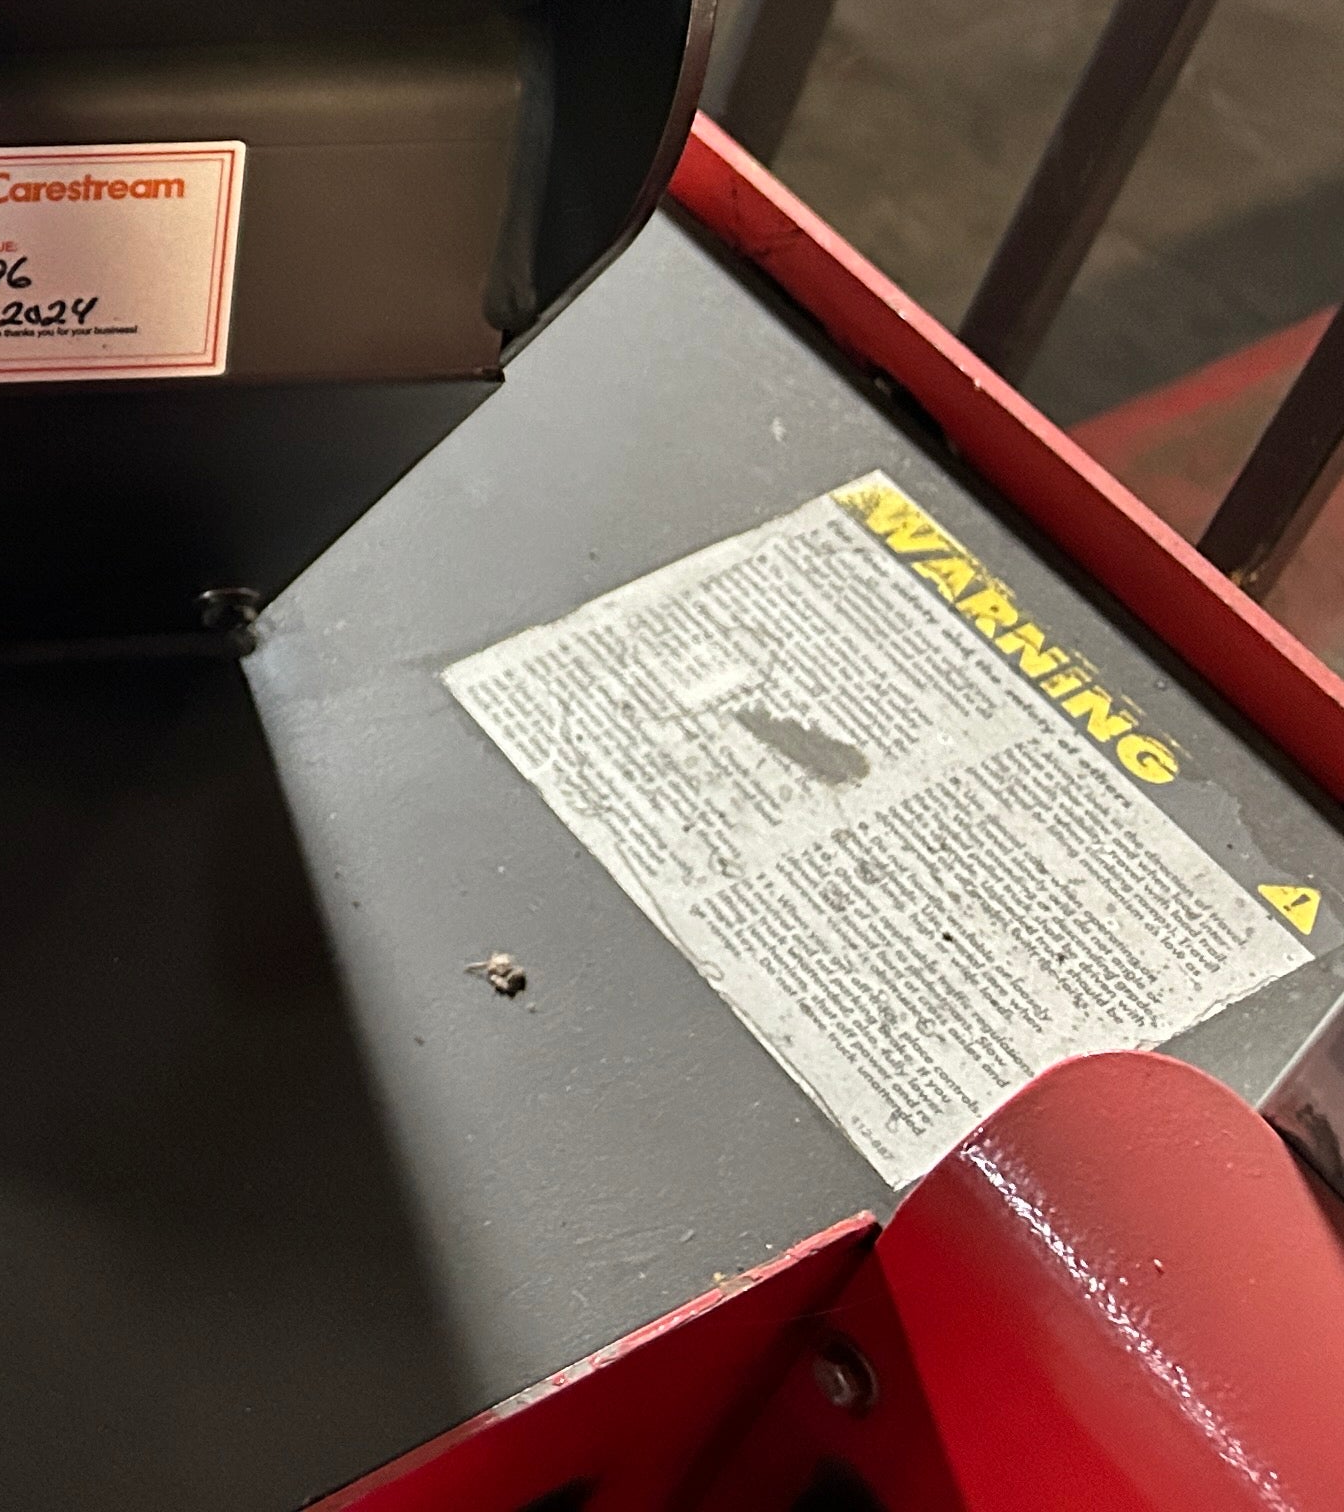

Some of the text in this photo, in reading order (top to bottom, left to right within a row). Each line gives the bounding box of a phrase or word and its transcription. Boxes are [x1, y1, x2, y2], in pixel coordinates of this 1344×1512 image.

[865, 486, 1179, 784] WARNING
[973, 657, 1006, 684] the
[1055, 736, 1080, 756] of
[1075, 755, 1135, 809] others
[1135, 859, 1173, 893] when
[1169, 892, 1201, 920] load
[1142, 883, 1173, 909] with
[1169, 909, 1202, 937] load
[1193, 897, 1211, 911] of
[949, 955, 982, 986] wide
[1071, 916, 1094, 934] do
[1089, 934, 1114, 955] not
[1108, 955, 1149, 991] angle
[1145, 991, 1161, 1005] or
[1080, 908, 1145, 969] operating
[1139, 966, 1158, 982] on
[1143, 921, 1161, 936] as
[1159, 936, 1187, 959] low
[1184, 961, 1201, 976] as
[1179, 937, 1219, 973] Travel
[981, 970, 1009, 996] care
[1008, 997, 1046, 1033] when
[993, 964, 1012, 981] or
[1006, 979, 1055, 1024] loosely
[1060, 942, 1081, 959] be
[1078, 960, 1120, 998] driven
[1116, 999, 1148, 1027] with
[1065, 967, 1108, 1007] should
[1104, 1007, 1126, 1025] be
[835, 1019, 857, 1039] off
[850, 1040, 892, 1083] power
[890, 1081, 919, 1109] and
[897, 1029, 936, 1066] place
[947, 1026, 984, 1061] aisles
[980, 1061, 1009, 1088] and
[975, 1036, 1009, 1068] Slow
[826, 1031, 860, 1064] truck
[856, 1064, 925, 1136] unattended
[876, 1047, 911, 1079] fully
[906, 1077, 946, 1116] lower
[915, 1066, 930, 1078] If
[923, 1079, 951, 1105] you
